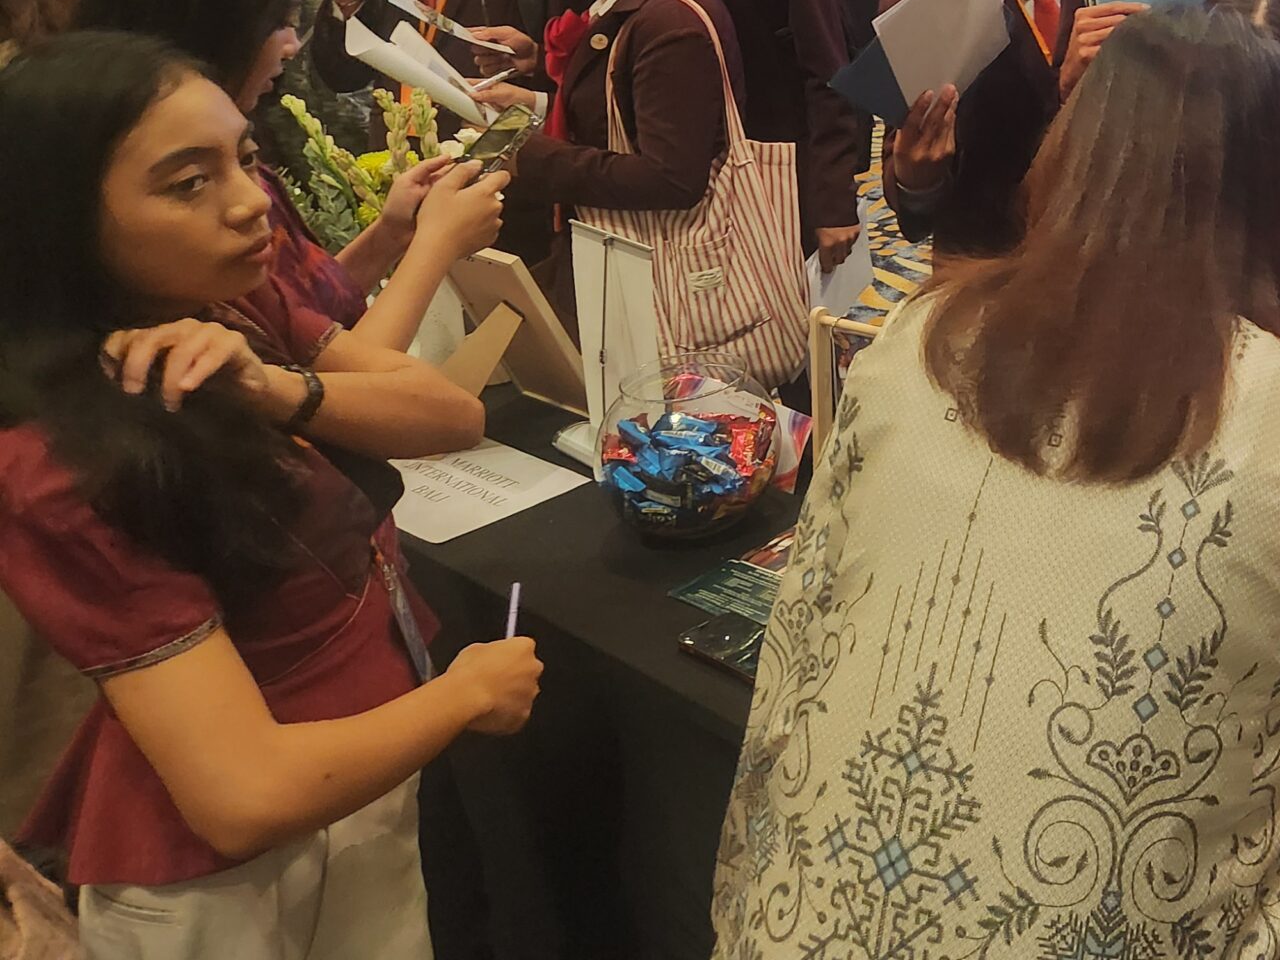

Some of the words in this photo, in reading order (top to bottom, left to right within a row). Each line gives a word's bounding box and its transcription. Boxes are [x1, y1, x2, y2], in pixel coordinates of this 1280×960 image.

[404, 462, 508, 506] INTERNATIONAL
[450, 457, 520, 489] MARRIOTT
[411, 485, 451, 503] BALI
